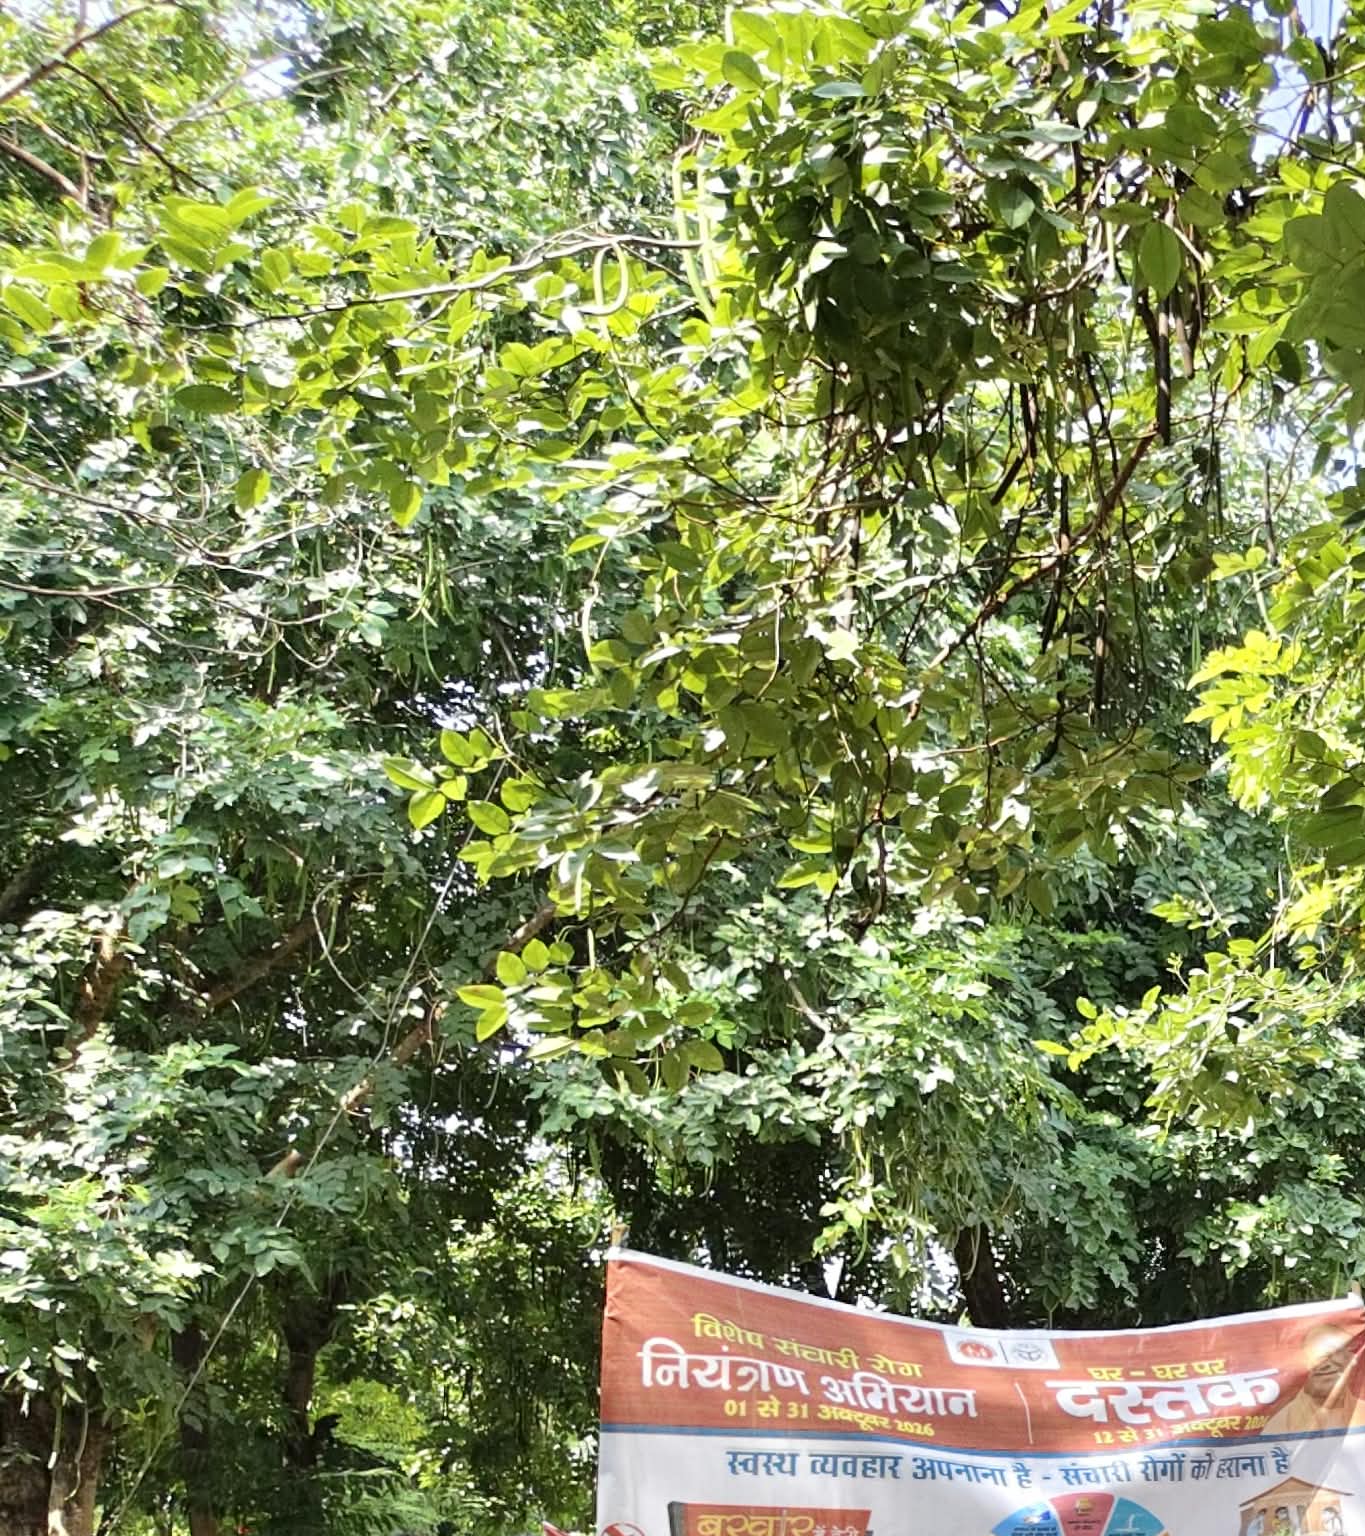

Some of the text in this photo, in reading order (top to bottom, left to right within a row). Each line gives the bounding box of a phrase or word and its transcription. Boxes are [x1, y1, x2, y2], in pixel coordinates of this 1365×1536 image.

[691, 1313, 923, 1378] विशेष संचारी रोग
[637, 1337, 979, 1418] नियंत्रण अभियान
[1087, 1366, 1123, 1383] घर
[1152, 1362, 1189, 1381] घर
[1193, 1358, 1228, 1377] पर
[724, 1399, 747, 1417] 01
[757, 1395, 781, 1418] से
[787, 1403, 809, 1418] 31
[1045, 1367, 1281, 1424] दस्तक
[1093, 1430, 1113, 1446] 12
[1117, 1426, 1140, 1446] से
[726, 1450, 801, 1478] स्वस्थ
[808, 1453, 904, 1480] व्यवहार
[912, 1457, 1007, 1486] अपनाना
[1012, 1462, 1034, 1489] है
[1059, 1460, 1132, 1488] संचारी
[1141, 1452, 1186, 1482] रोगों
[1190, 1457, 1211, 1482] को
[1214, 1453, 1265, 1480] हराना
[1271, 1446, 1291, 1475] है
